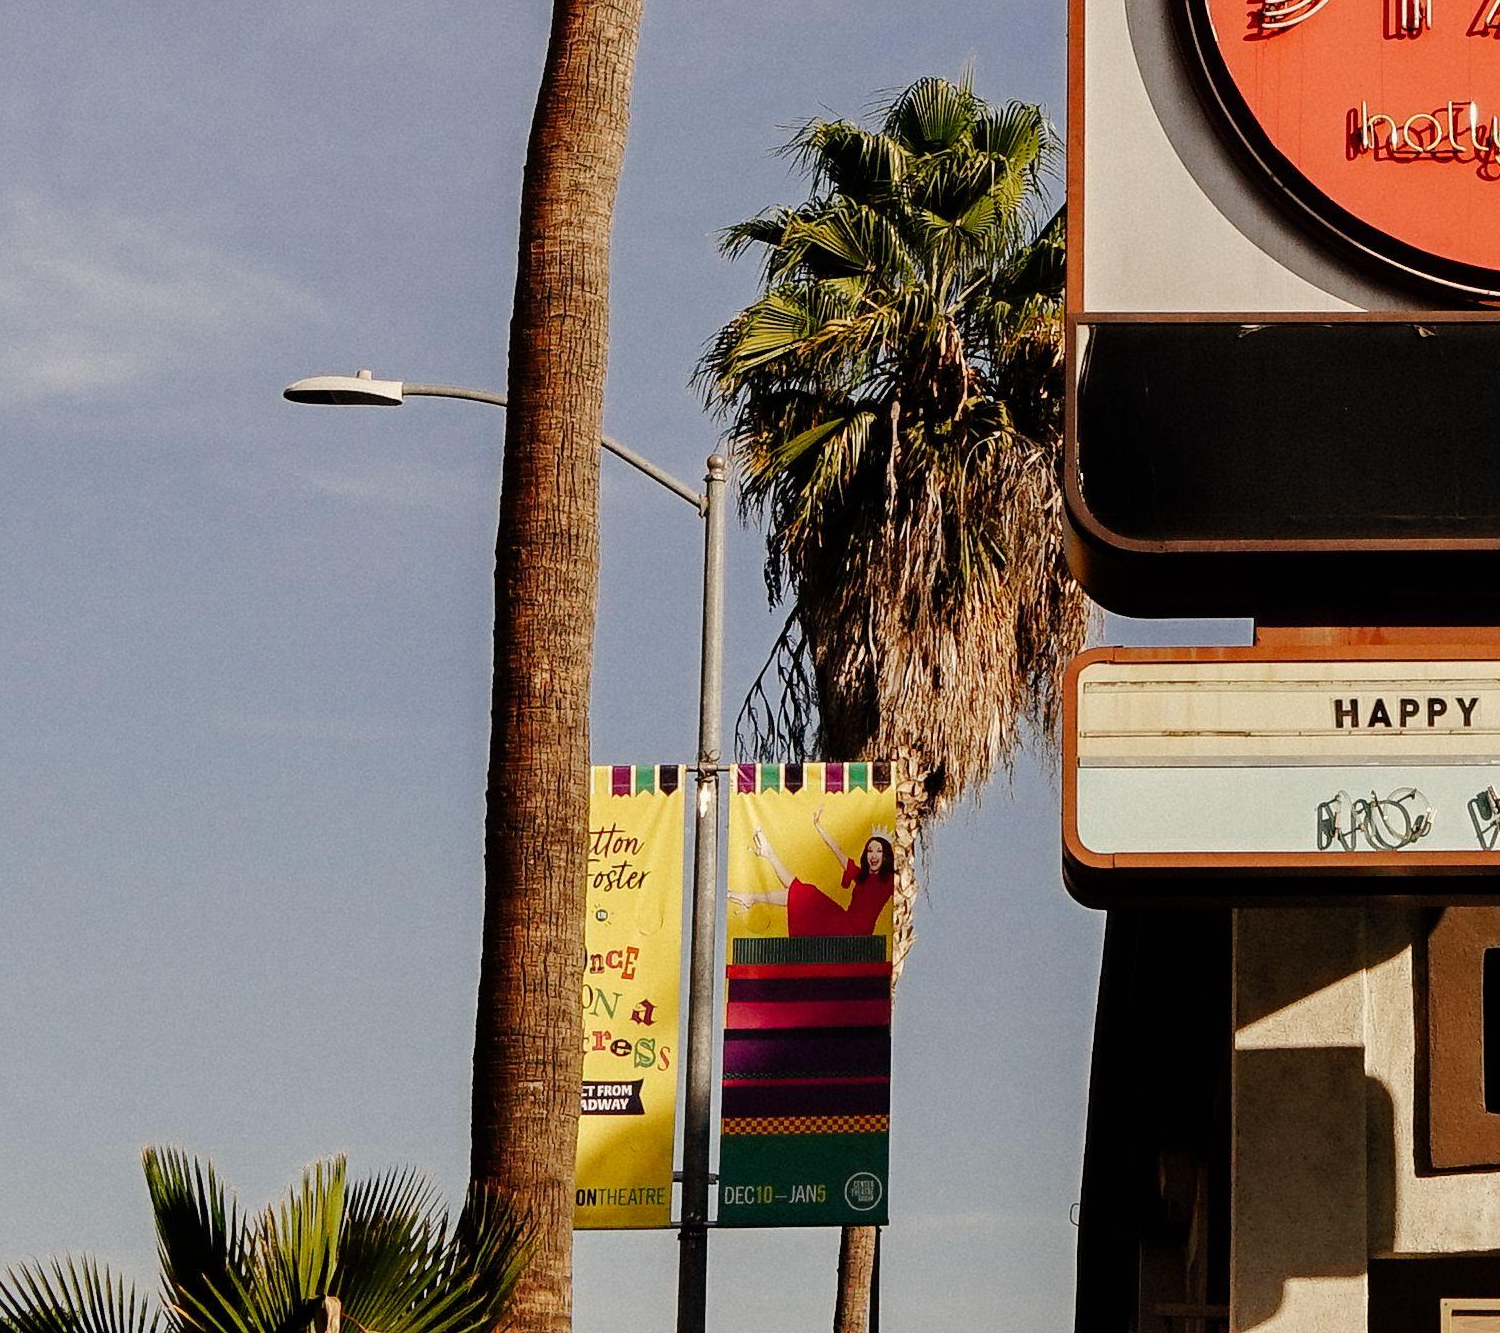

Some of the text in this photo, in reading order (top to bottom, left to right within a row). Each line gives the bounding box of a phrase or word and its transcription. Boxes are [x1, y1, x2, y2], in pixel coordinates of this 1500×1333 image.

[1334, 697, 1479, 729] HAPPY
[587, 821, 645, 859] tton
[629, 998, 658, 1027] a
[582, 1026, 671, 1071] ress
[580, 1097, 630, 1111] ADWAY
[597, 1084, 633, 1097] FROM
